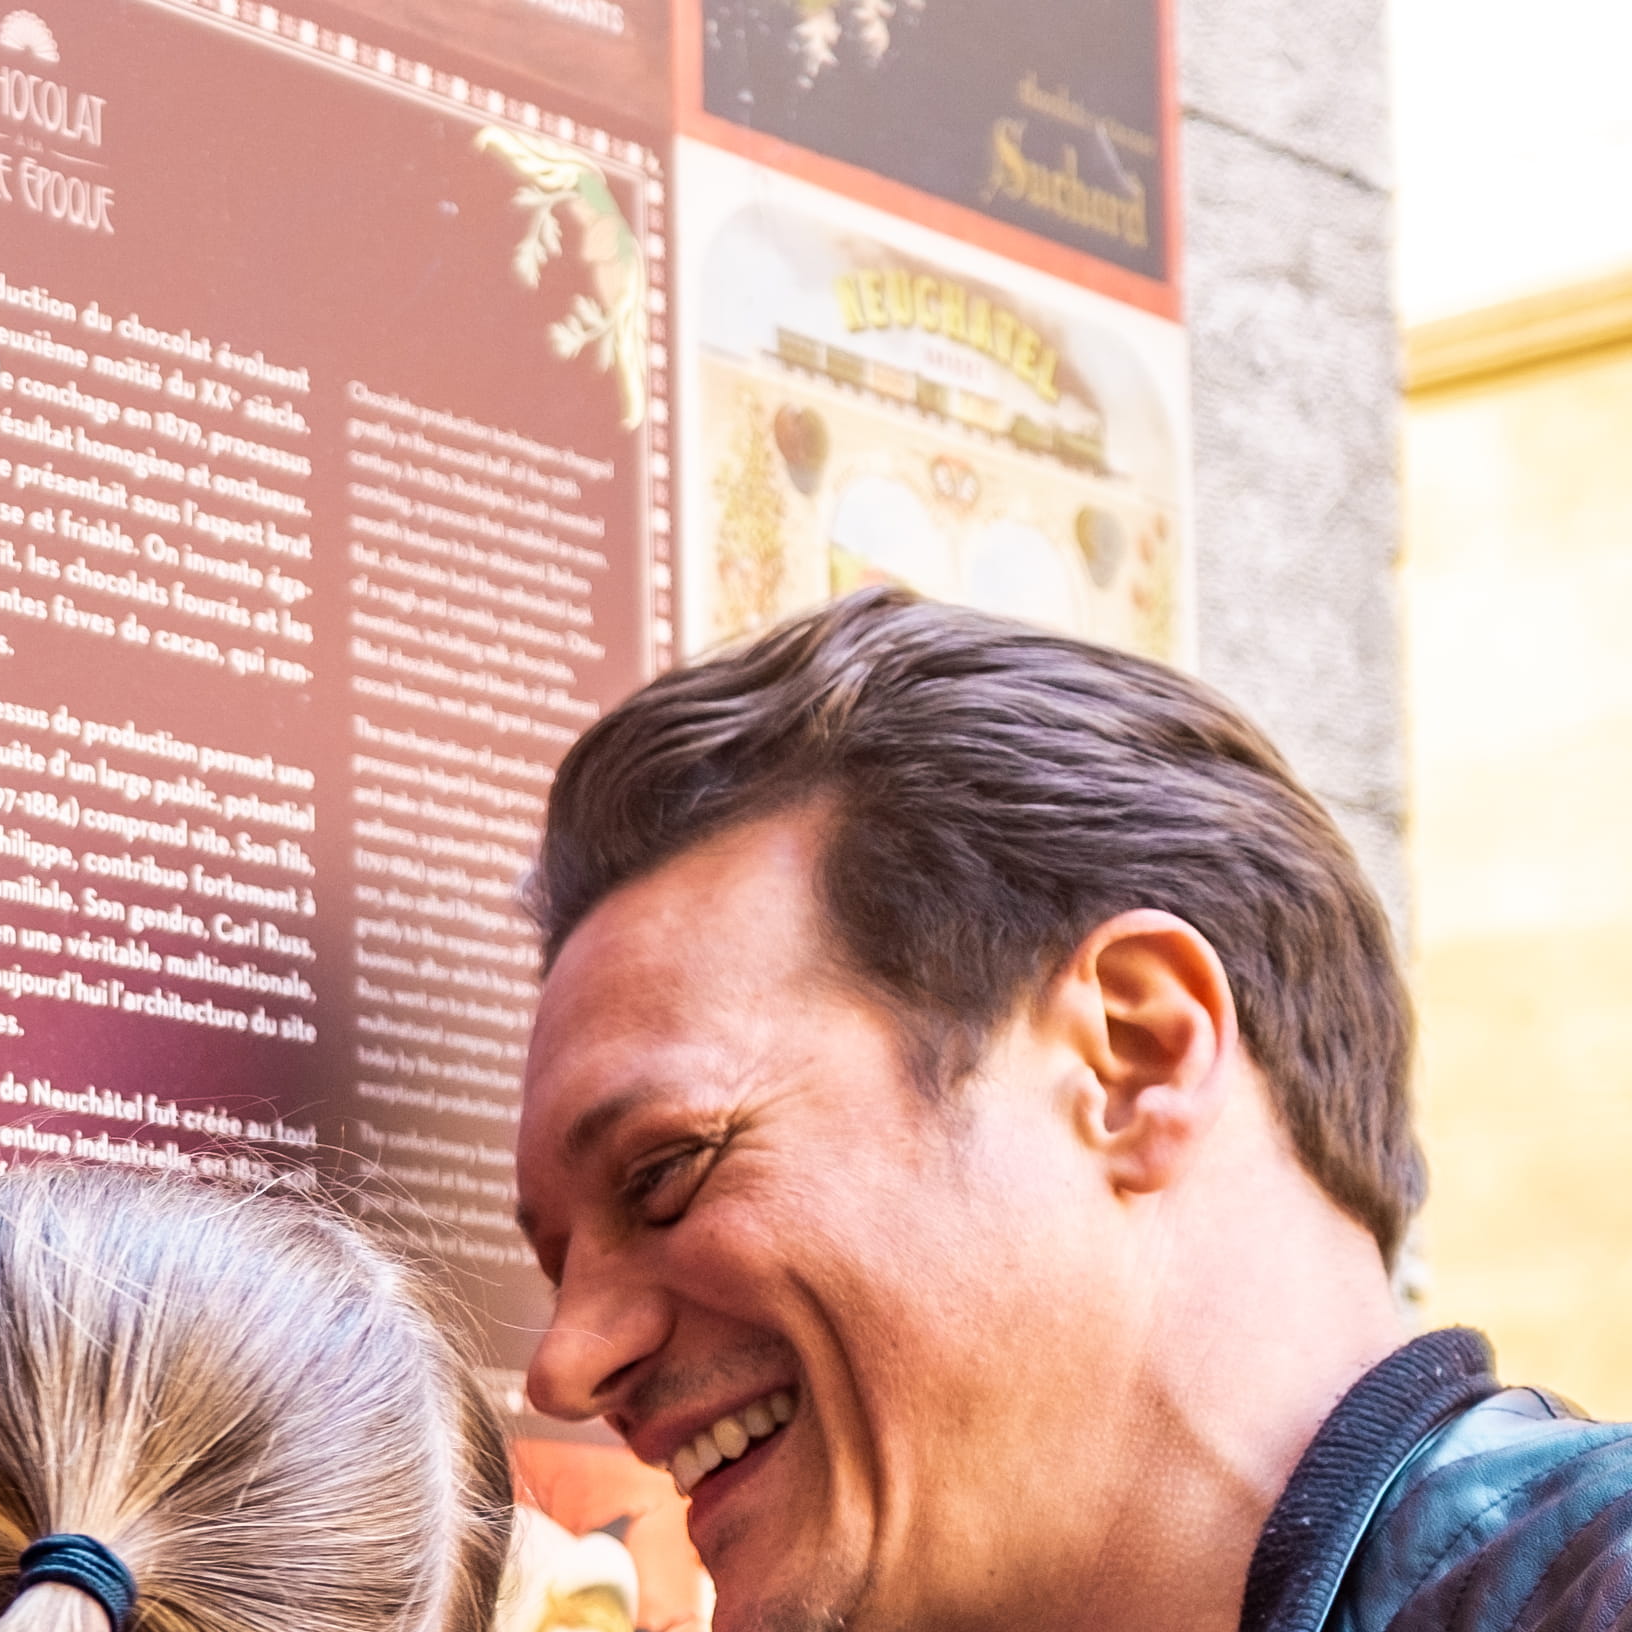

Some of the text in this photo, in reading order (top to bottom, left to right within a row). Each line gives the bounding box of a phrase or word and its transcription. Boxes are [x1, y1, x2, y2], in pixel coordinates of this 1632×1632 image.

[82, 301, 112, 333] du
[117, 314, 212, 363] chocolat
[51, 705, 81, 737] de
[83, 720, 199, 764] production
[198, 747, 275, 781] permet
[275, 765, 314, 790] une
[81, 808, 187, 847] comprend
[191, 826, 236, 857] vite.
[237, 831, 277, 866] Son
[278, 839, 314, 876] fils,
[31, 1079, 143, 1122] Neuchâtel
